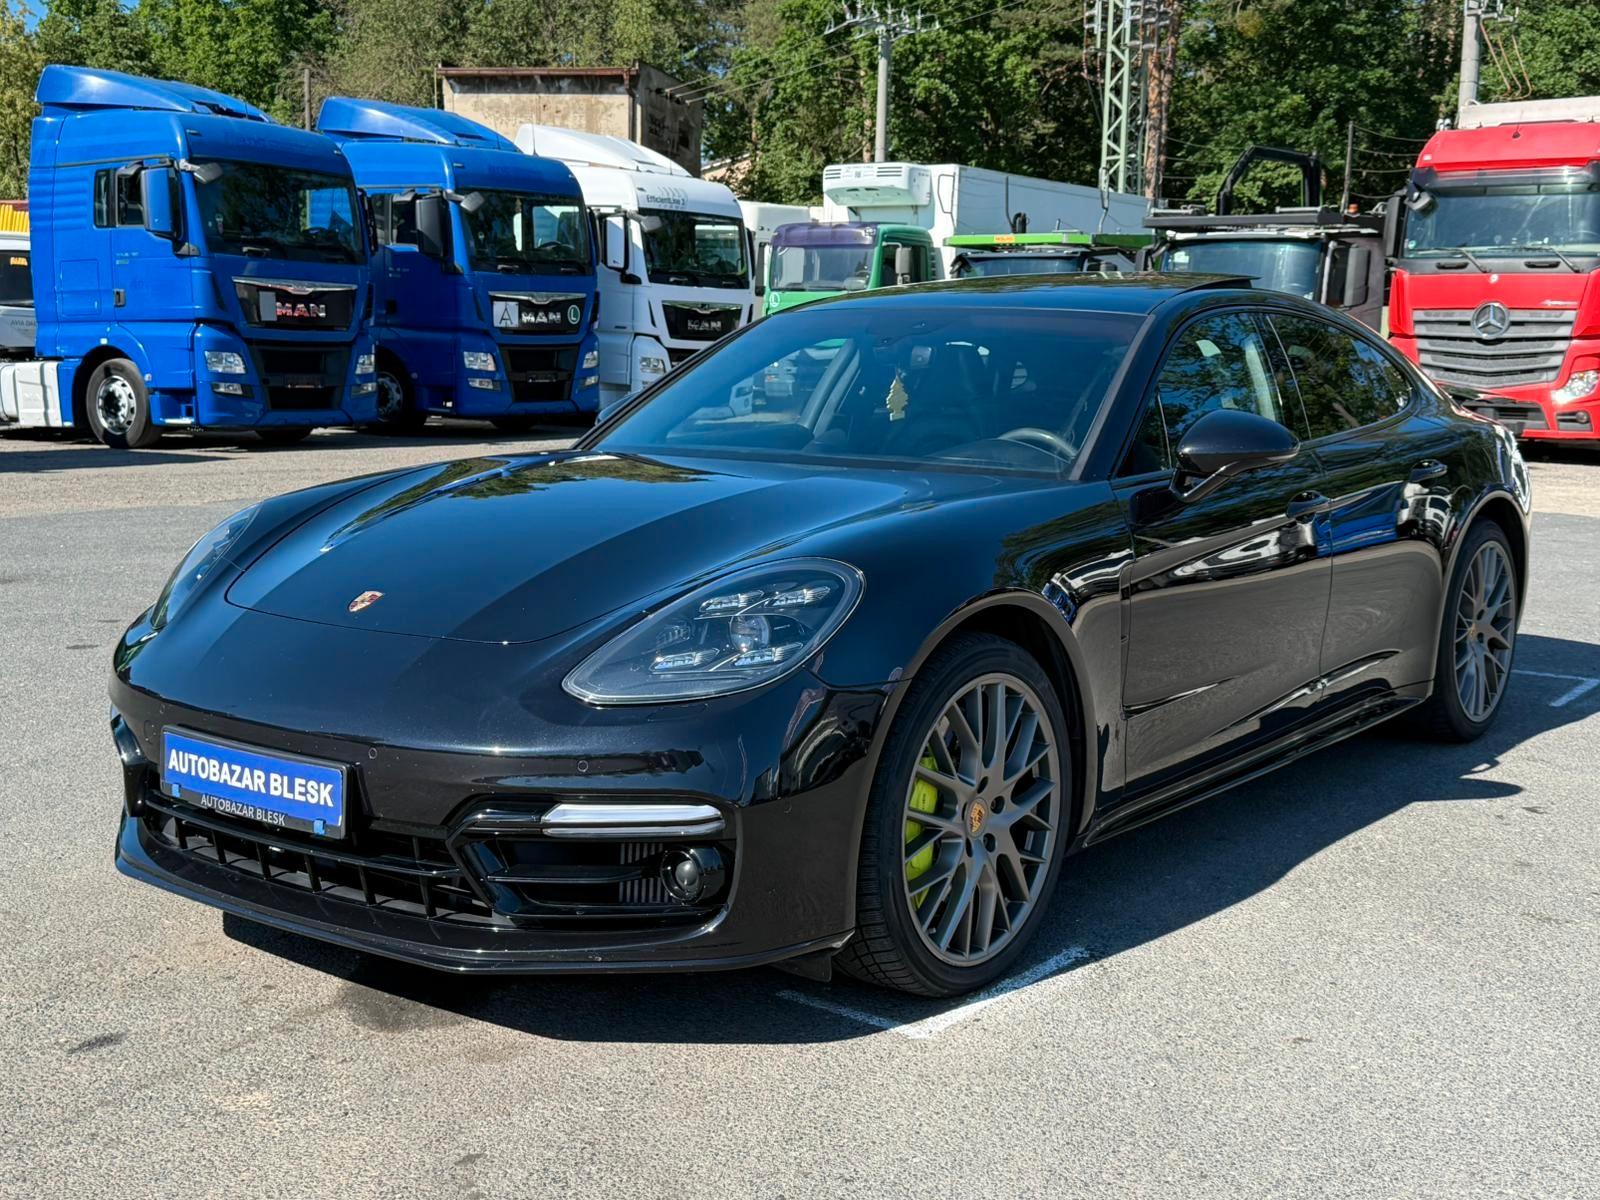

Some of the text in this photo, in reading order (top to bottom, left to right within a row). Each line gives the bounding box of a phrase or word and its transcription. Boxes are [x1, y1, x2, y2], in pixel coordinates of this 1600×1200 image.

[275, 302, 326, 317] MAN
[499, 303, 513, 325] A
[521, 311, 561, 323] MAN
[687, 319, 721, 331] MAN
[168, 748, 334, 807] AUTOBAZAR BLESK
[201, 794, 286, 826] AUTOBAZAR BLESK
